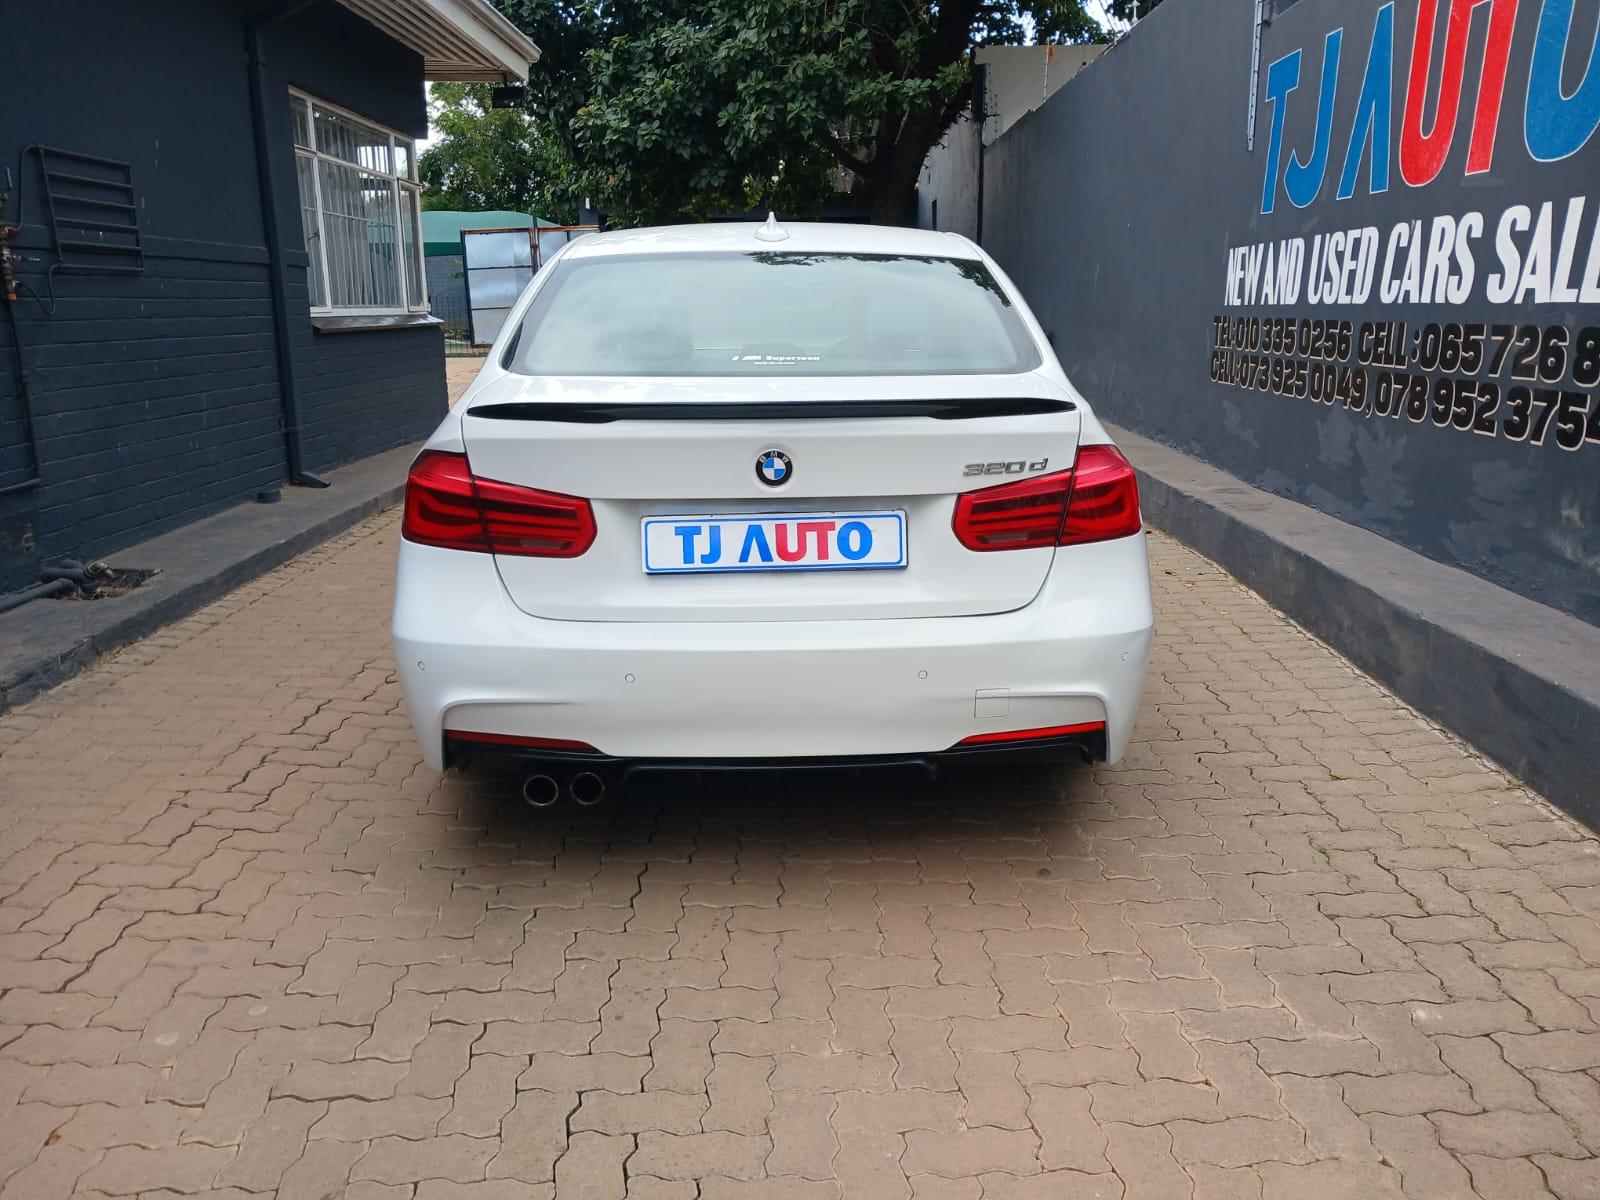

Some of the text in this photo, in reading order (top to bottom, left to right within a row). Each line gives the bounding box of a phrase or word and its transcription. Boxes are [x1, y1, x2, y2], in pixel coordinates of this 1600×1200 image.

[1260, 27, 1343, 214] TJ
[1224, 244, 1265, 306] NEW
[1260, 237, 1306, 305] AND
[1307, 226, 1380, 305] USED
[1380, 211, 1484, 305] CARS
[1262, 318, 1298, 356] 335
[1299, 318, 1354, 362] 0256
[1488, 324, 1569, 383] 726
[1272, 357, 1310, 398] 925
[1431, 376, 1500, 437] 952
[674, 521, 873, 564] TJ AUTO
